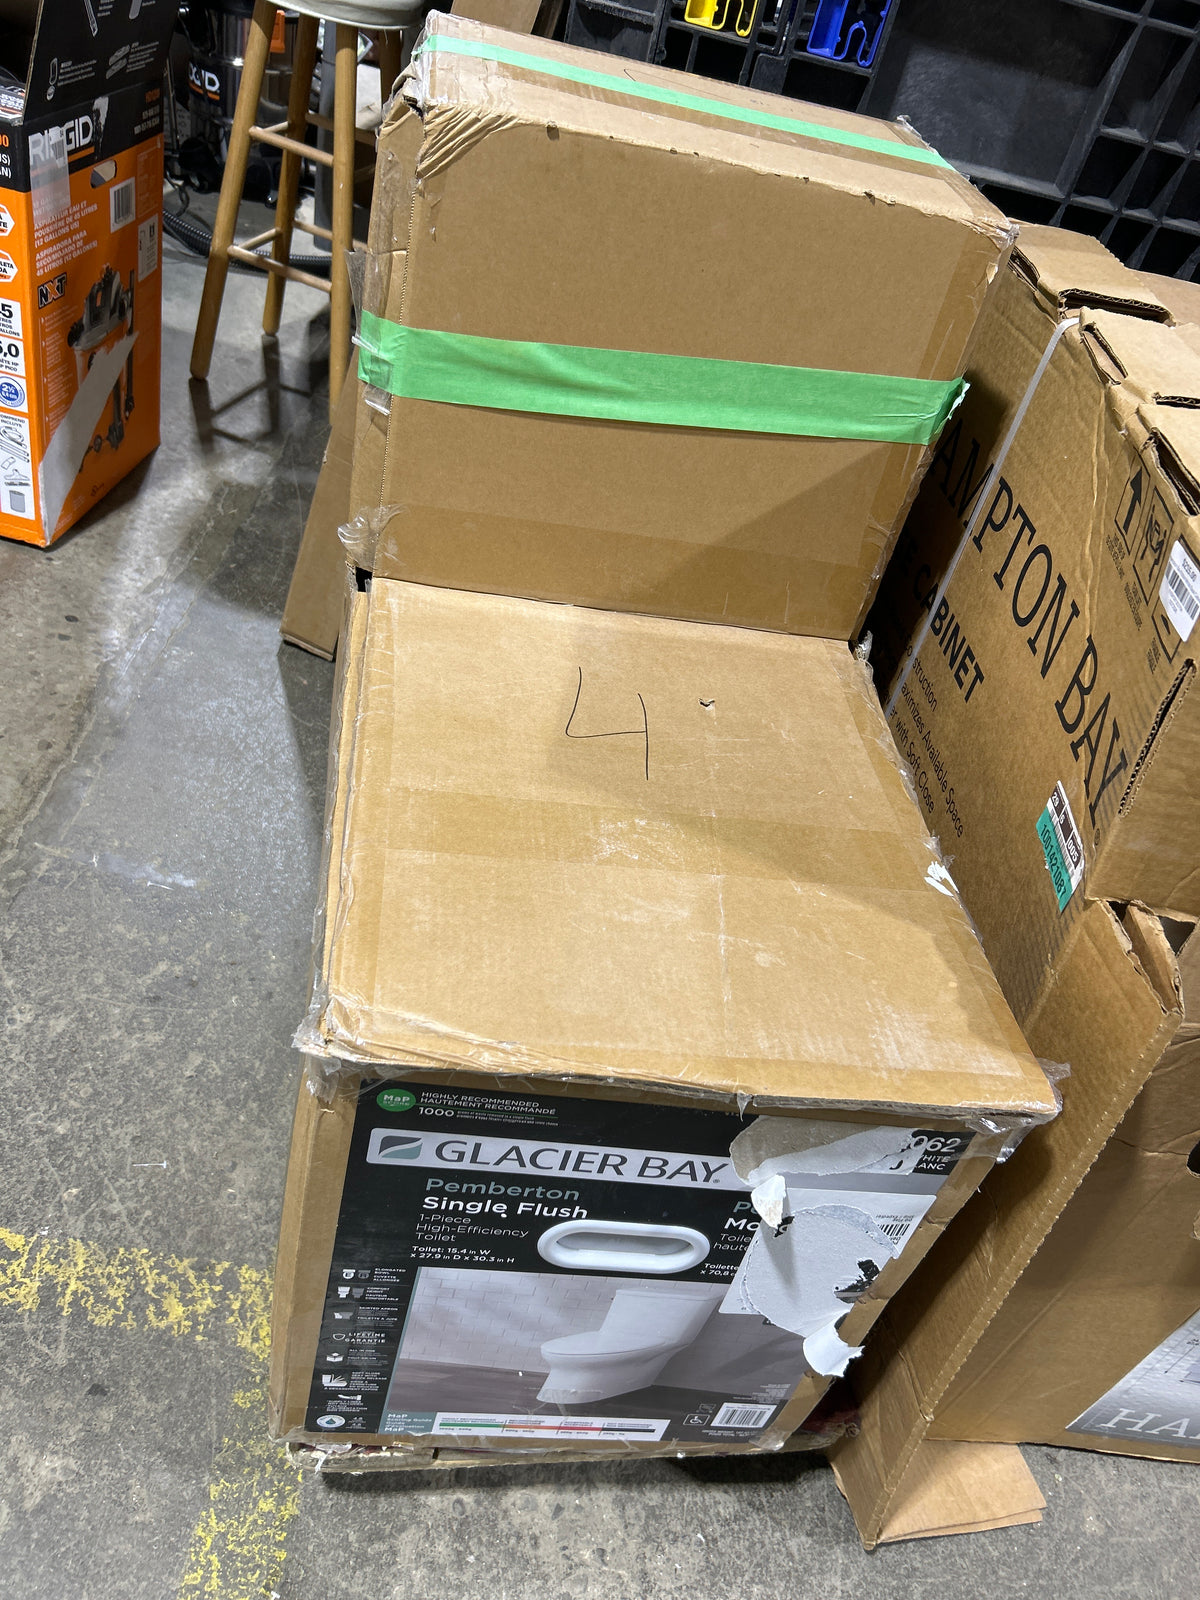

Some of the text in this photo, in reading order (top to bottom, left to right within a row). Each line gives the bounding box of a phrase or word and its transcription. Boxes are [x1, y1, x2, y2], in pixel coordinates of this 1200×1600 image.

[38, 272, 67, 309] NXT
[0, 303, 13, 319] 5
[903, 632, 938, 714] Costruction
[565, 666, 649, 780] 4
[1055, 634, 1128, 829] BAY
[896, 713, 935, 814] with Soft Close
[922, 726, 948, 790] Available
[946, 788, 964, 838] Space
[418, 1106, 455, 1117] 1000
[420, 1097, 556, 1115] HAUTEMENT RECOMMANDÉ
[422, 1092, 540, 1108] HIGHLY RECOMMENDED
[434, 1140, 729, 1182] GLACIER BAY
[920, 1154, 951, 1163] HITE
[426, 1178, 580, 1201] Pemberton
[420, 1214, 472, 1224] 1-Piece
[422, 1196, 588, 1219] Single Flush
[416, 1223, 529, 1238] High-Efficiency
[416, 1232, 456, 1242] Toilet
[1096, 1408, 1200, 1440] HA
